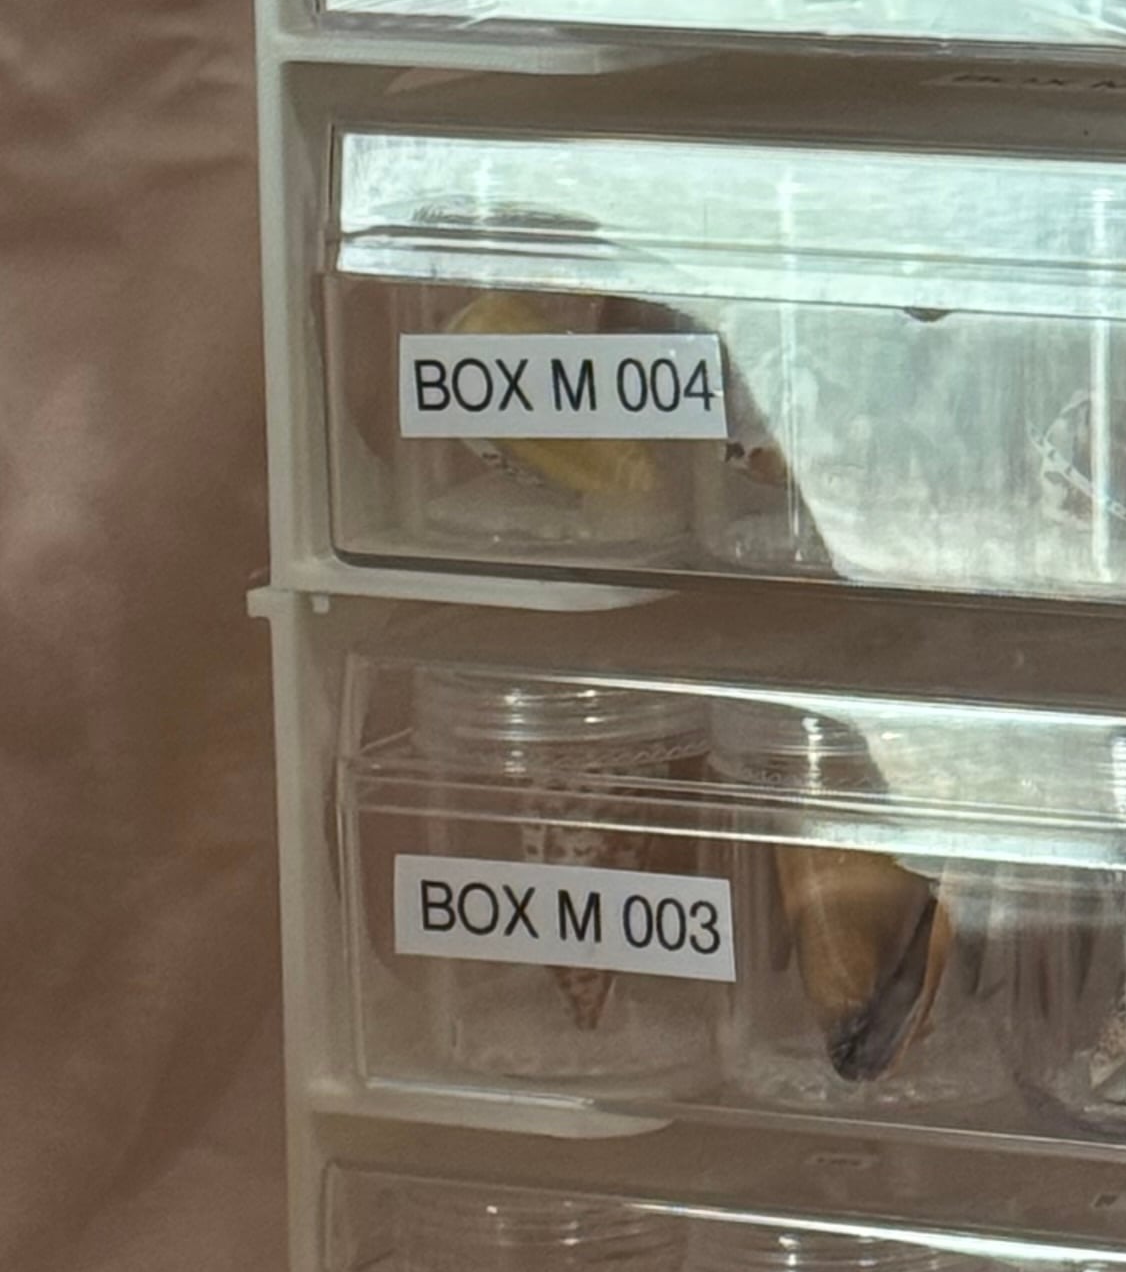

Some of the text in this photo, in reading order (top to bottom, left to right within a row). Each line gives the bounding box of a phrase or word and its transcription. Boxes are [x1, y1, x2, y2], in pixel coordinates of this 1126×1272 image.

[414, 357, 715, 413] BOX M 004
[420, 879, 721, 955] BOX M 003
